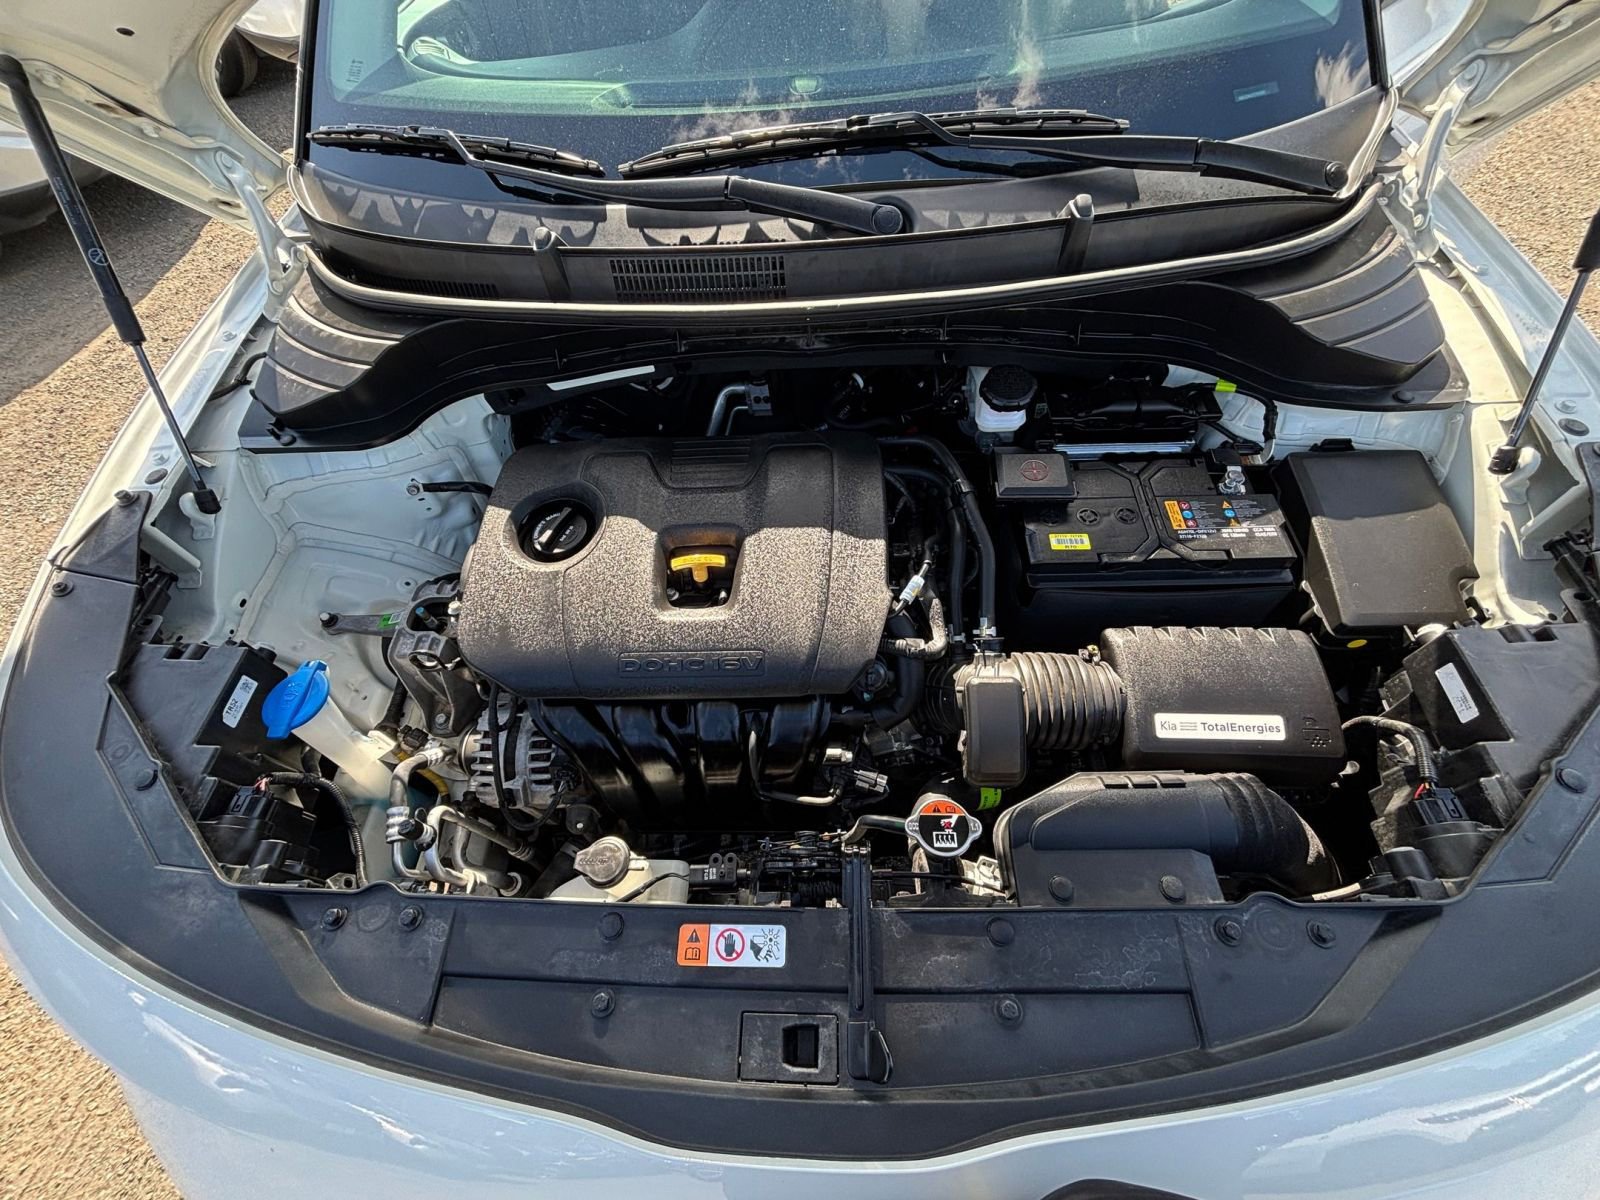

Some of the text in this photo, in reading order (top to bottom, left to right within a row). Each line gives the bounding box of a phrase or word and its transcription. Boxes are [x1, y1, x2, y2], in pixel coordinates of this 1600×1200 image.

[620, 656, 763, 672] DOHC 16V
[1160, 720, 1281, 734] Kia TotalEnergies
